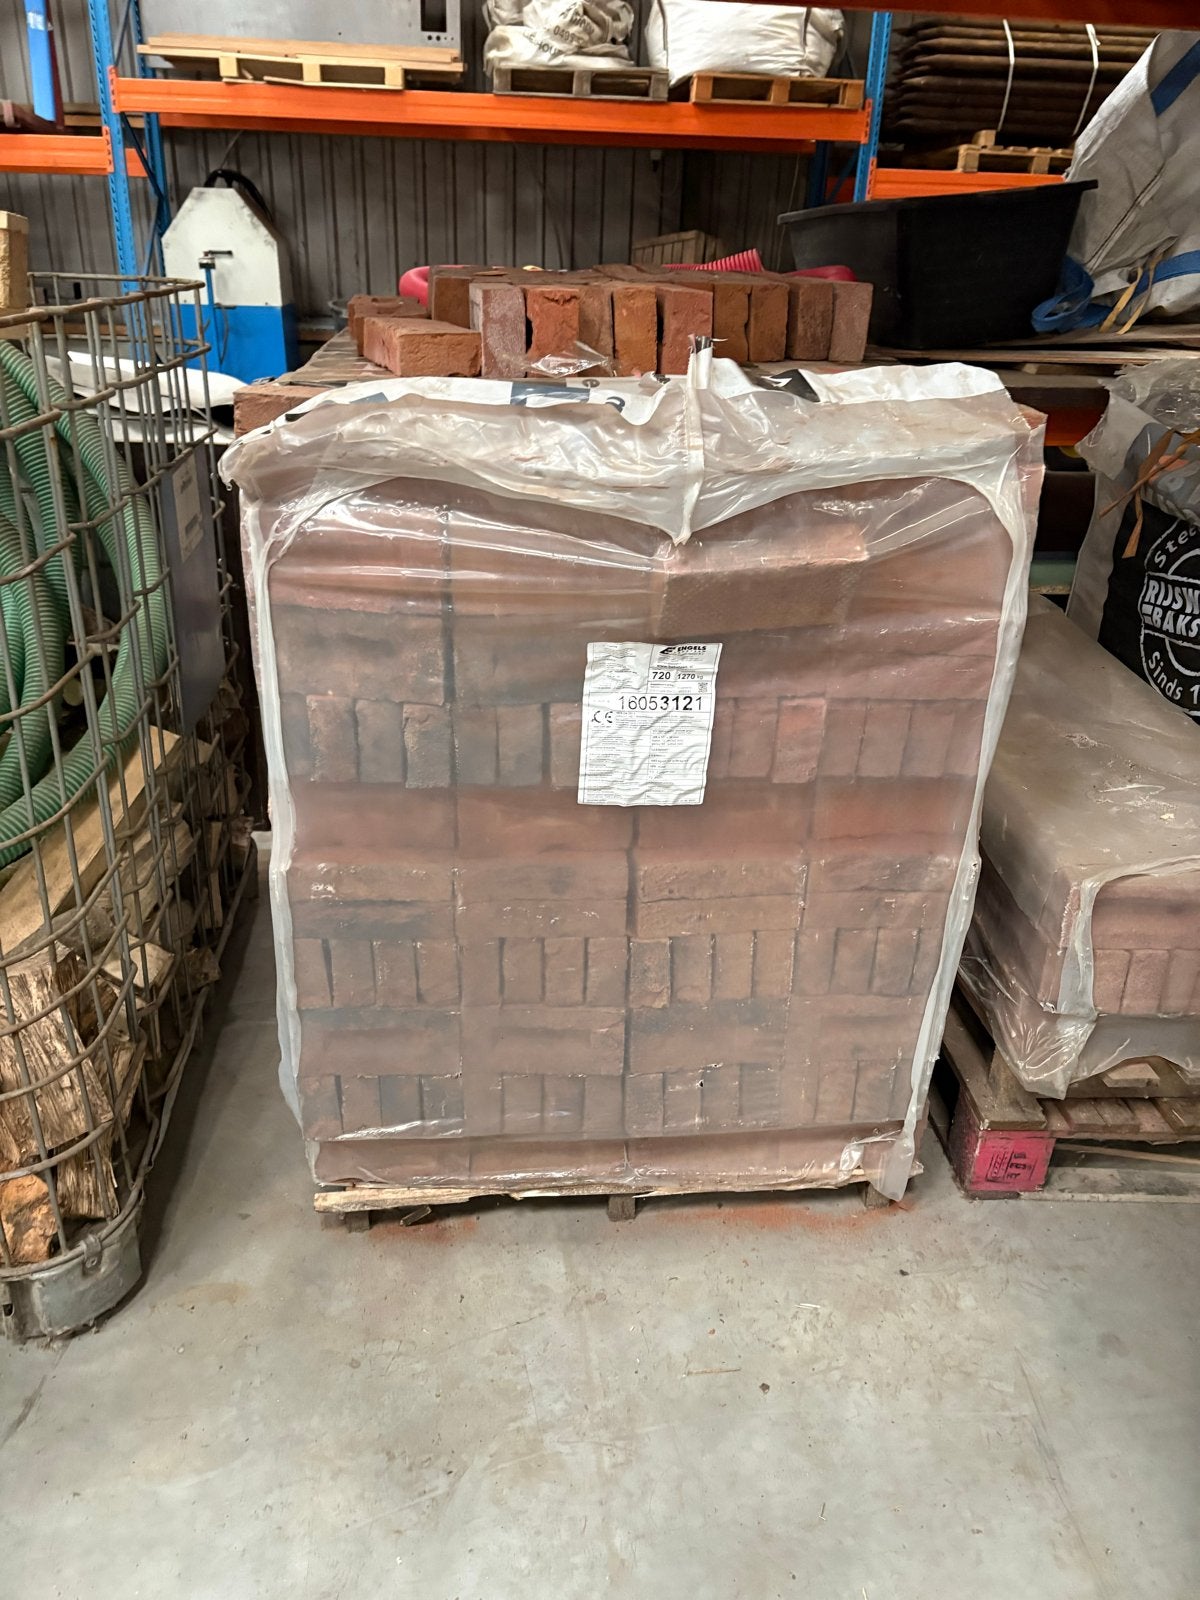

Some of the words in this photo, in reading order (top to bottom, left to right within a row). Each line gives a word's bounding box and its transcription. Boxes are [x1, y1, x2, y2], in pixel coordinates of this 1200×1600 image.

[1152, 606, 1200, 638] BAKS
[652, 671, 671, 680] 720
[1149, 651, 1183, 700] Sinds
[1190, 684, 1200, 705] 1
[619, 695, 702, 711] 16053121
